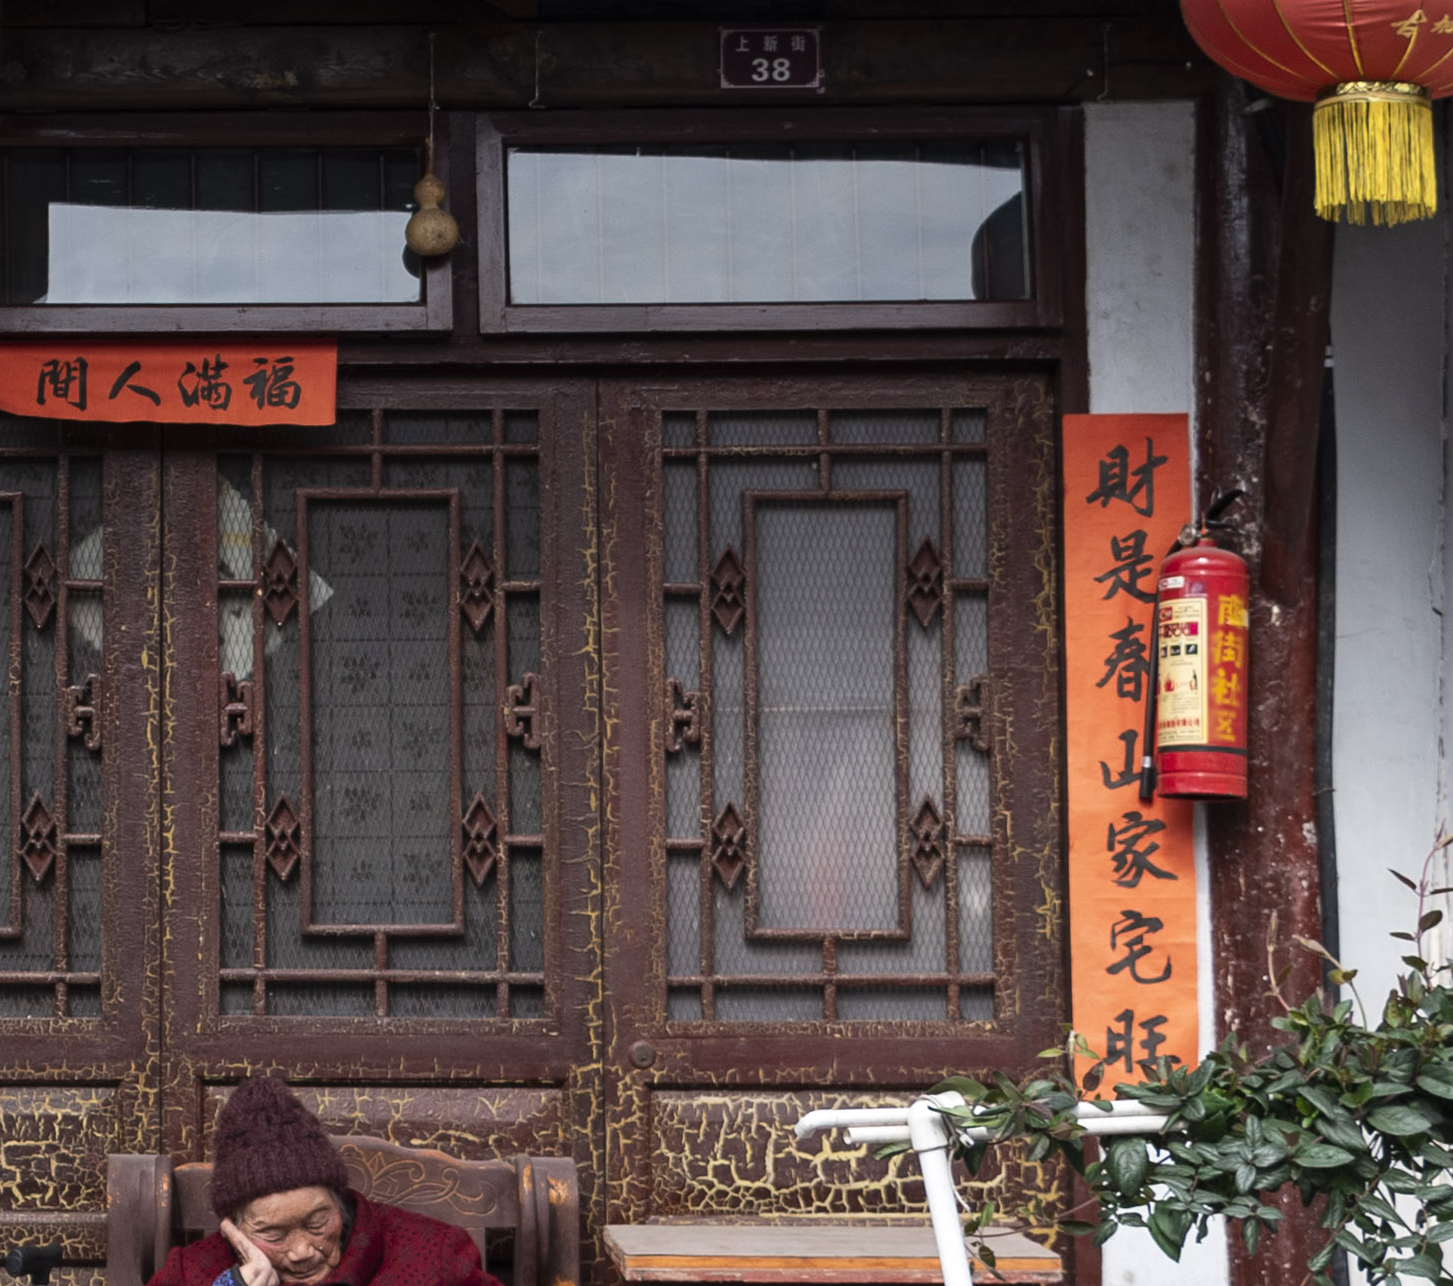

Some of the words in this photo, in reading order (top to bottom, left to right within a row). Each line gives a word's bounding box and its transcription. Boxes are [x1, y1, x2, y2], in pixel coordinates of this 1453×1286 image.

[735, 35, 806, 52] 上新街
[751, 57, 791, 82] 38
